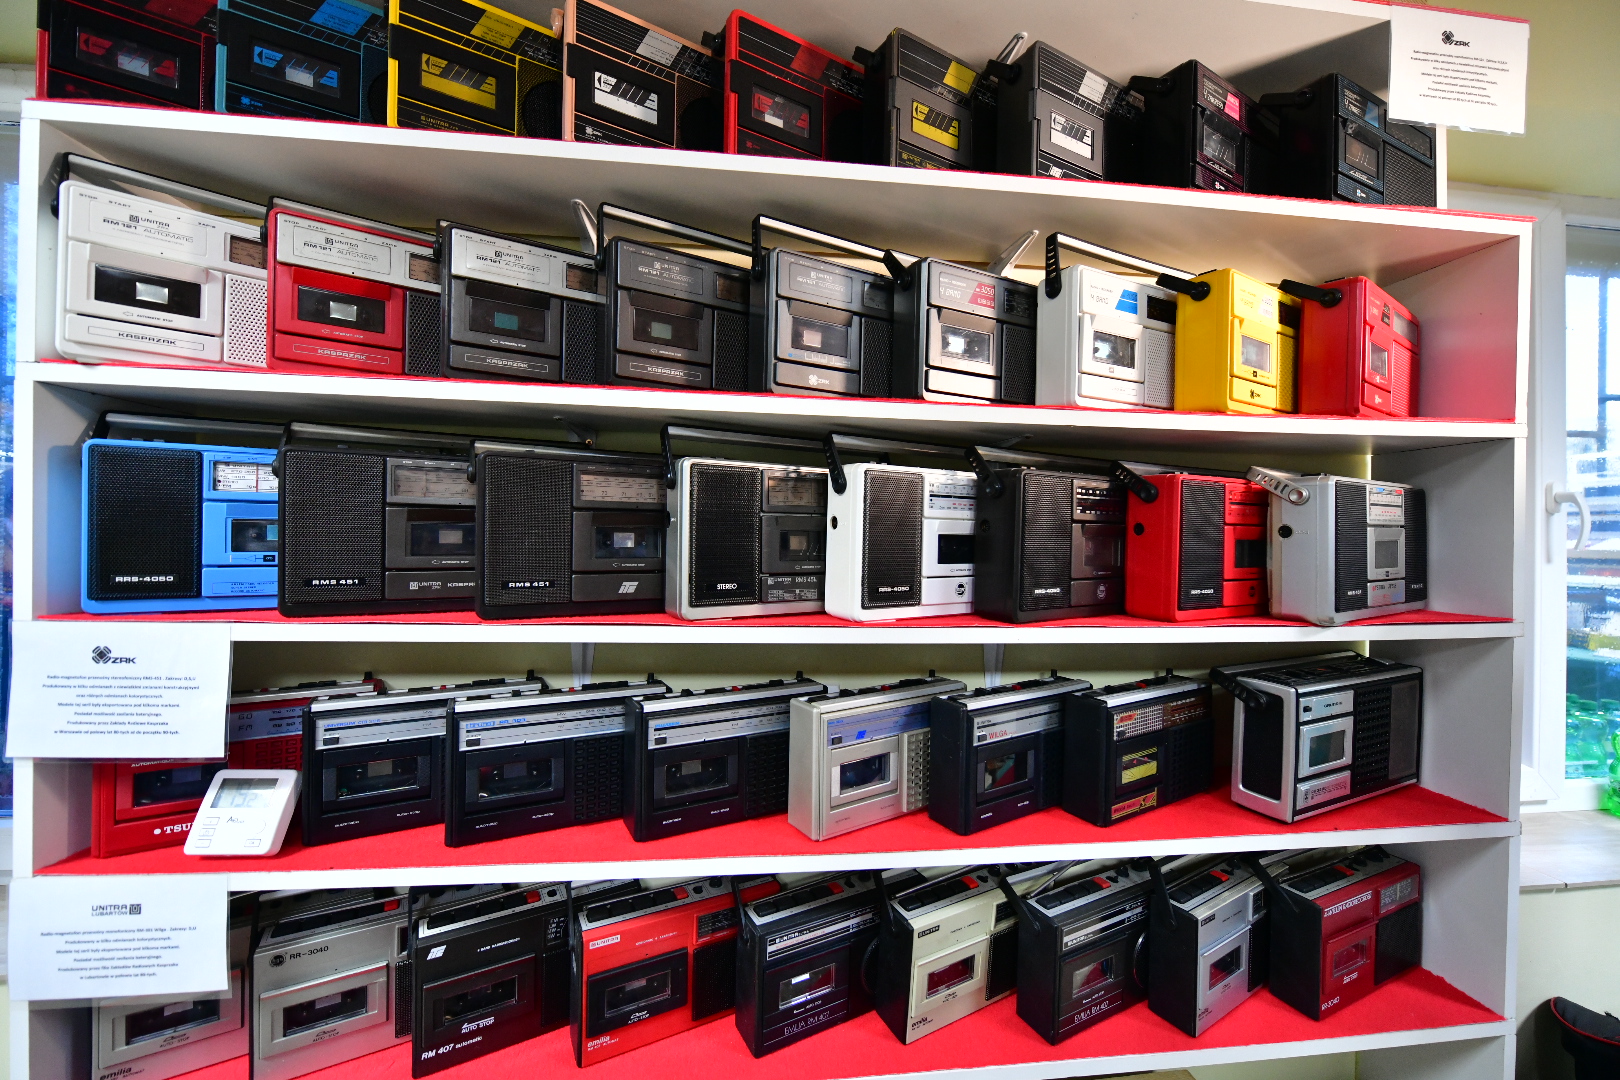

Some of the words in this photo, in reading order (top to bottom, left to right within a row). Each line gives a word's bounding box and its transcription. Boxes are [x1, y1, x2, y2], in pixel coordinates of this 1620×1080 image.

[141, 217, 170, 228] UNITRA
[103, 218, 120, 226] RM
[143, 228, 194, 243] AUTOMATIC
[335, 239, 359, 248] UNITRA
[989, 730, 1008, 739] WILGA
[164, 822, 193, 834] TSU
[289, 946, 329, 960] RR-3040
[461, 1024, 478, 1034] AUTO
[479, 1019, 494, 1028] STOP
[421, 1048, 436, 1060] RM
[438, 1043, 454, 1054] 407
[456, 1036, 482, 1048] automatic
[588, 1035, 610, 1048] emilia
[100, 1066, 132, 1080] emilia
